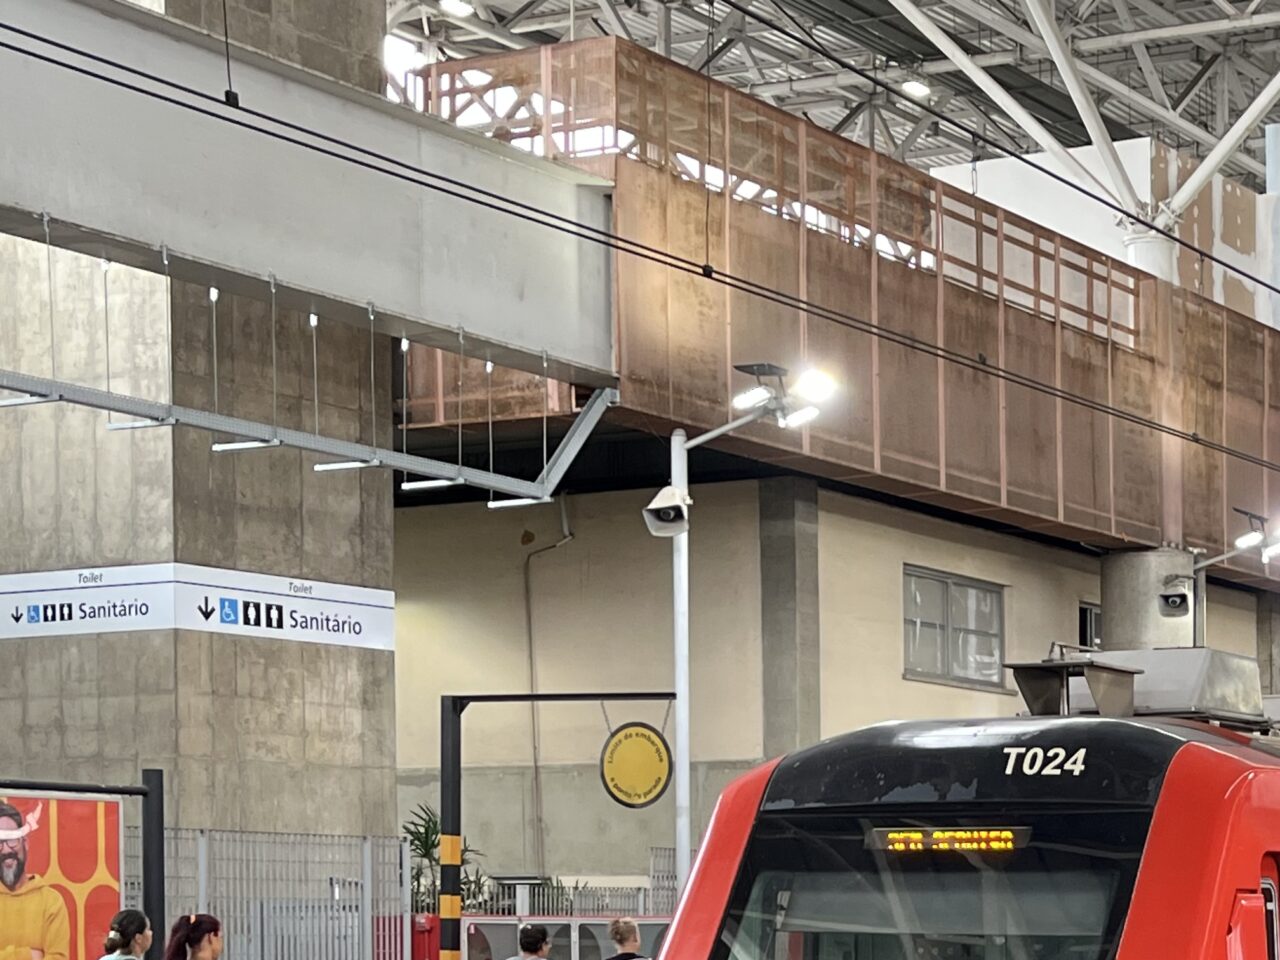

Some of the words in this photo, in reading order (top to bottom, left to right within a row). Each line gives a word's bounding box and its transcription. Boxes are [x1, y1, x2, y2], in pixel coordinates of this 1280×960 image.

[78, 571, 103, 584] Toilet
[288, 582, 313, 595] Toilet
[79, 599, 149, 620] Sanitário
[290, 610, 362, 635] Sanitário
[1003, 747, 1087, 776] T024
